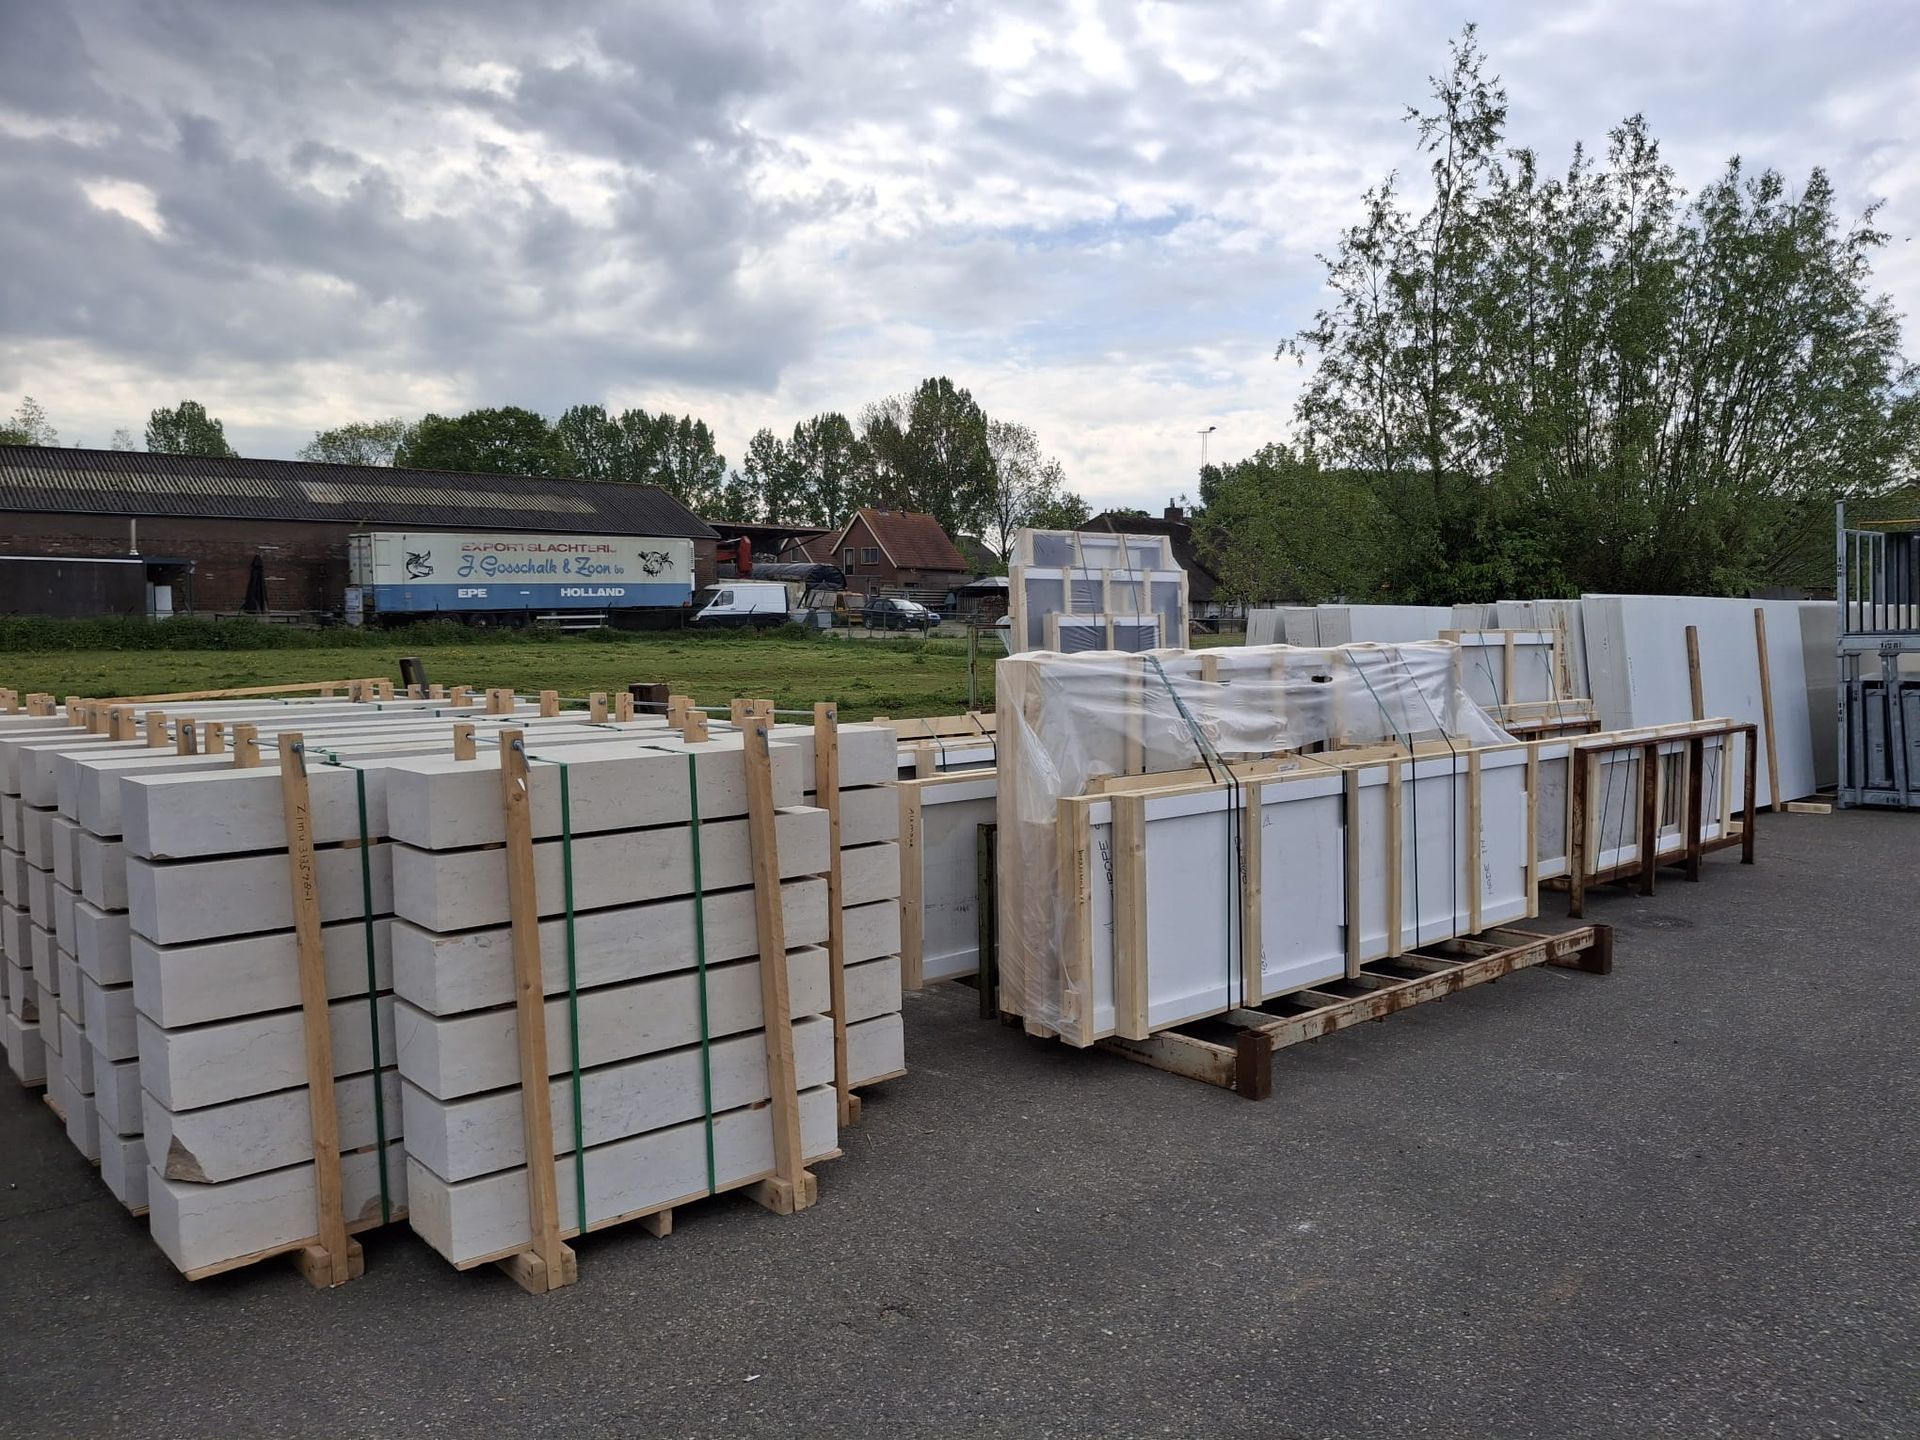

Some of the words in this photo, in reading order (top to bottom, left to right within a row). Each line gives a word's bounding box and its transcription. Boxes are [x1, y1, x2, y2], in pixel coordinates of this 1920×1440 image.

[479, 554, 557, 578] Gosschalk
[562, 556, 572, 575] &
[574, 555, 612, 578] Zoon
[457, 588, 488, 599] EPE
[560, 587, 626, 598] HOLLAND
